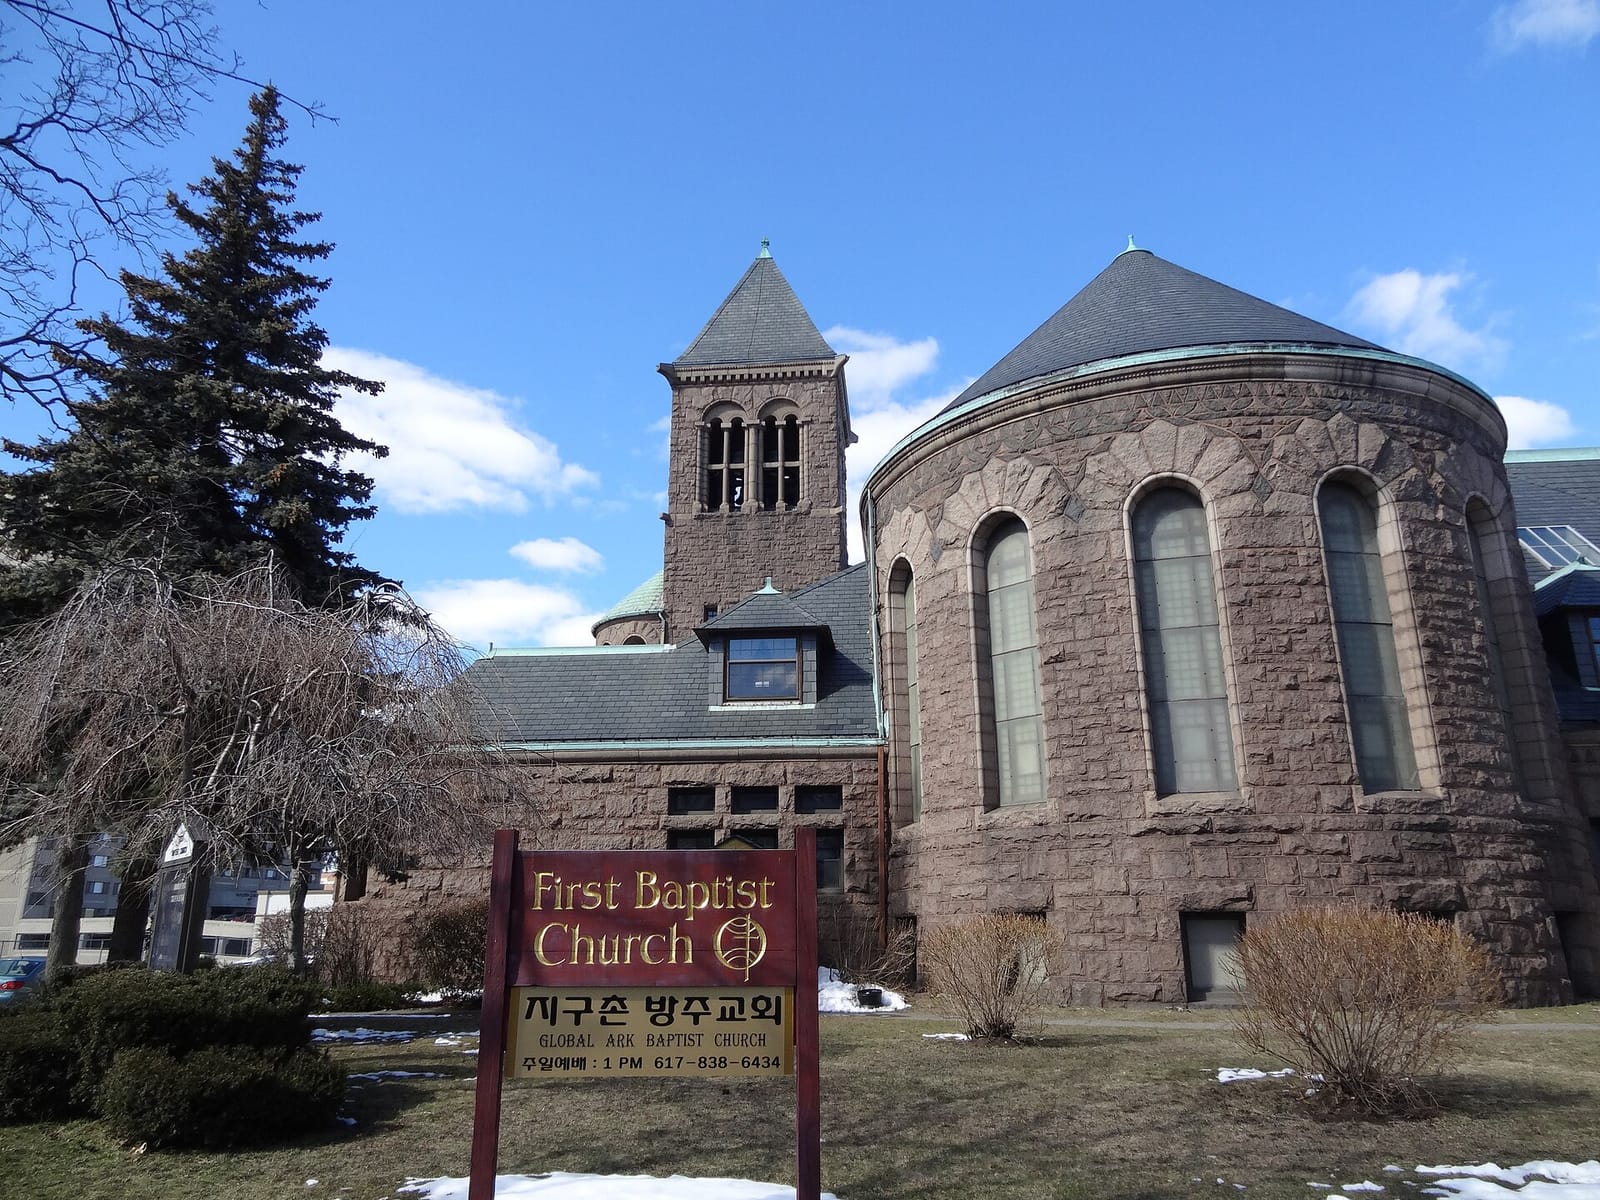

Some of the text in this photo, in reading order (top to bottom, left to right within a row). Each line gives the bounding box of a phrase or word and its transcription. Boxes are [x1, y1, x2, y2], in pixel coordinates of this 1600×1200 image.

[532, 870, 776, 921] First Baptist
[533, 922, 693, 966] Church
[525, 994, 782, 1026] 지구촌 방주교회
[539, 1033, 767, 1048] GLOBAL ARK BAPTIST CHURCH
[654, 1056, 781, 1070] 617-838-6434
